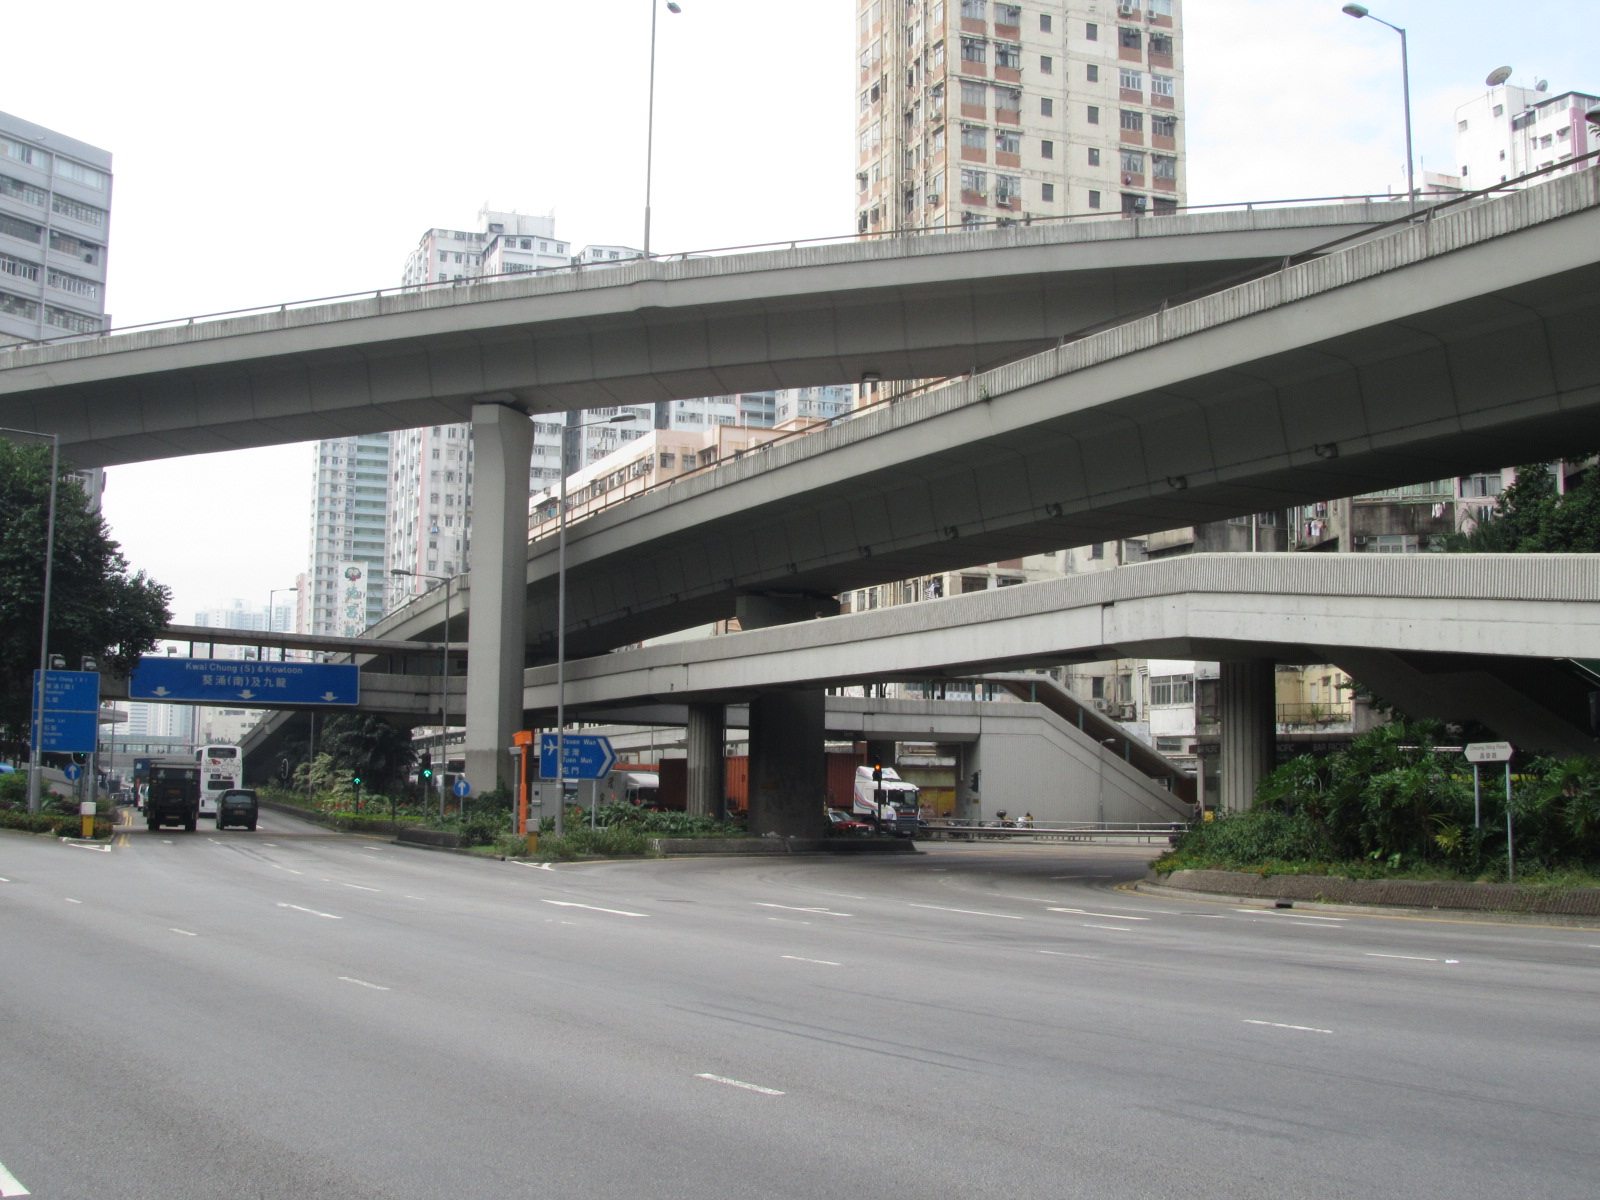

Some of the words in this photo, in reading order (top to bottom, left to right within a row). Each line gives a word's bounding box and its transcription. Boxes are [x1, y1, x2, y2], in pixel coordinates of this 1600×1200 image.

[186, 662, 208, 671] Kwai
[209, 663, 238, 673] Chung
[240, 664, 255, 674] (S)
[257, 665, 264, 673] &
[265, 665, 303, 674] Kowloon
[580, 756, 593, 764] Mun
